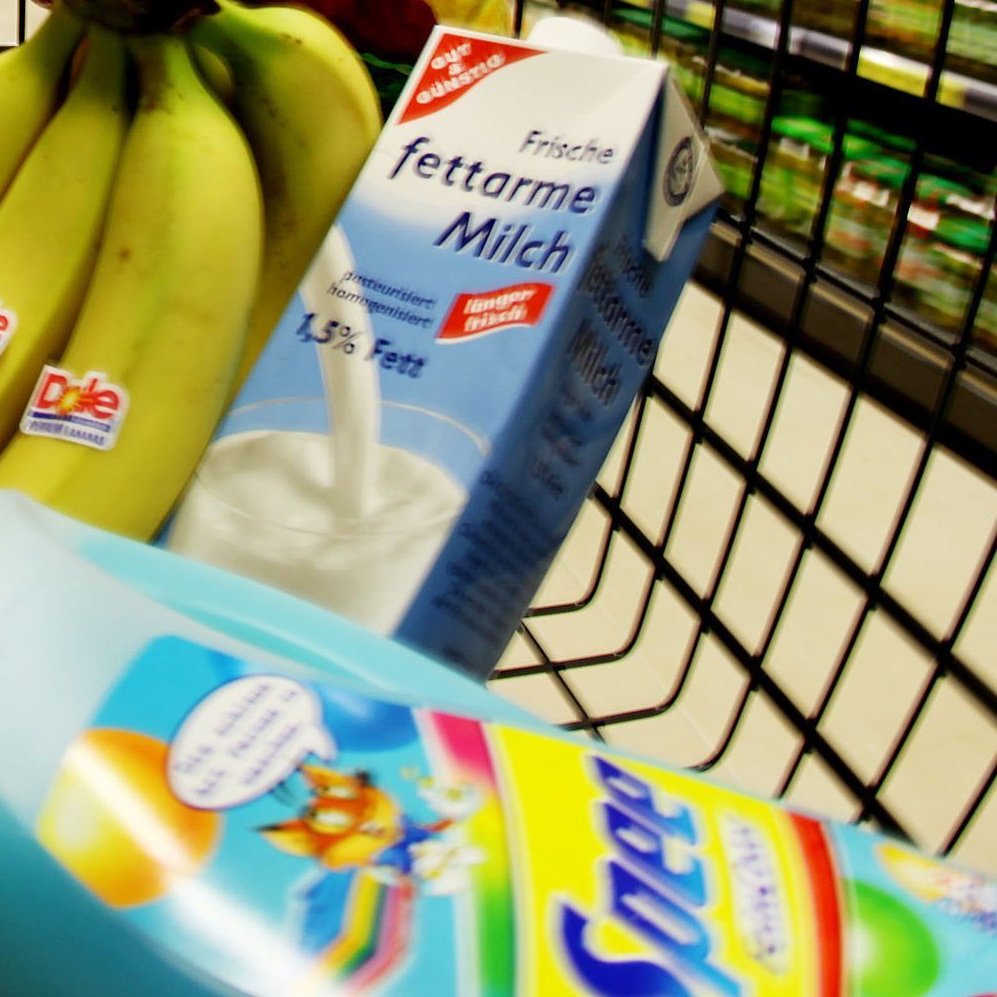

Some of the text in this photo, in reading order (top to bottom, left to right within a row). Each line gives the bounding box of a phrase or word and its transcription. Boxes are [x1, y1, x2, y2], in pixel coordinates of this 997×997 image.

[416, 53, 506, 104] GÜNSTIG
[431, 42, 472, 70] GUT
[519, 130, 614, 164] Frische
[387, 137, 597, 214] fettarme
[433, 211, 571, 273] Milch
[296, 312, 427, 379] 1,5% Fett
[36, 372, 120, 420] Dole
